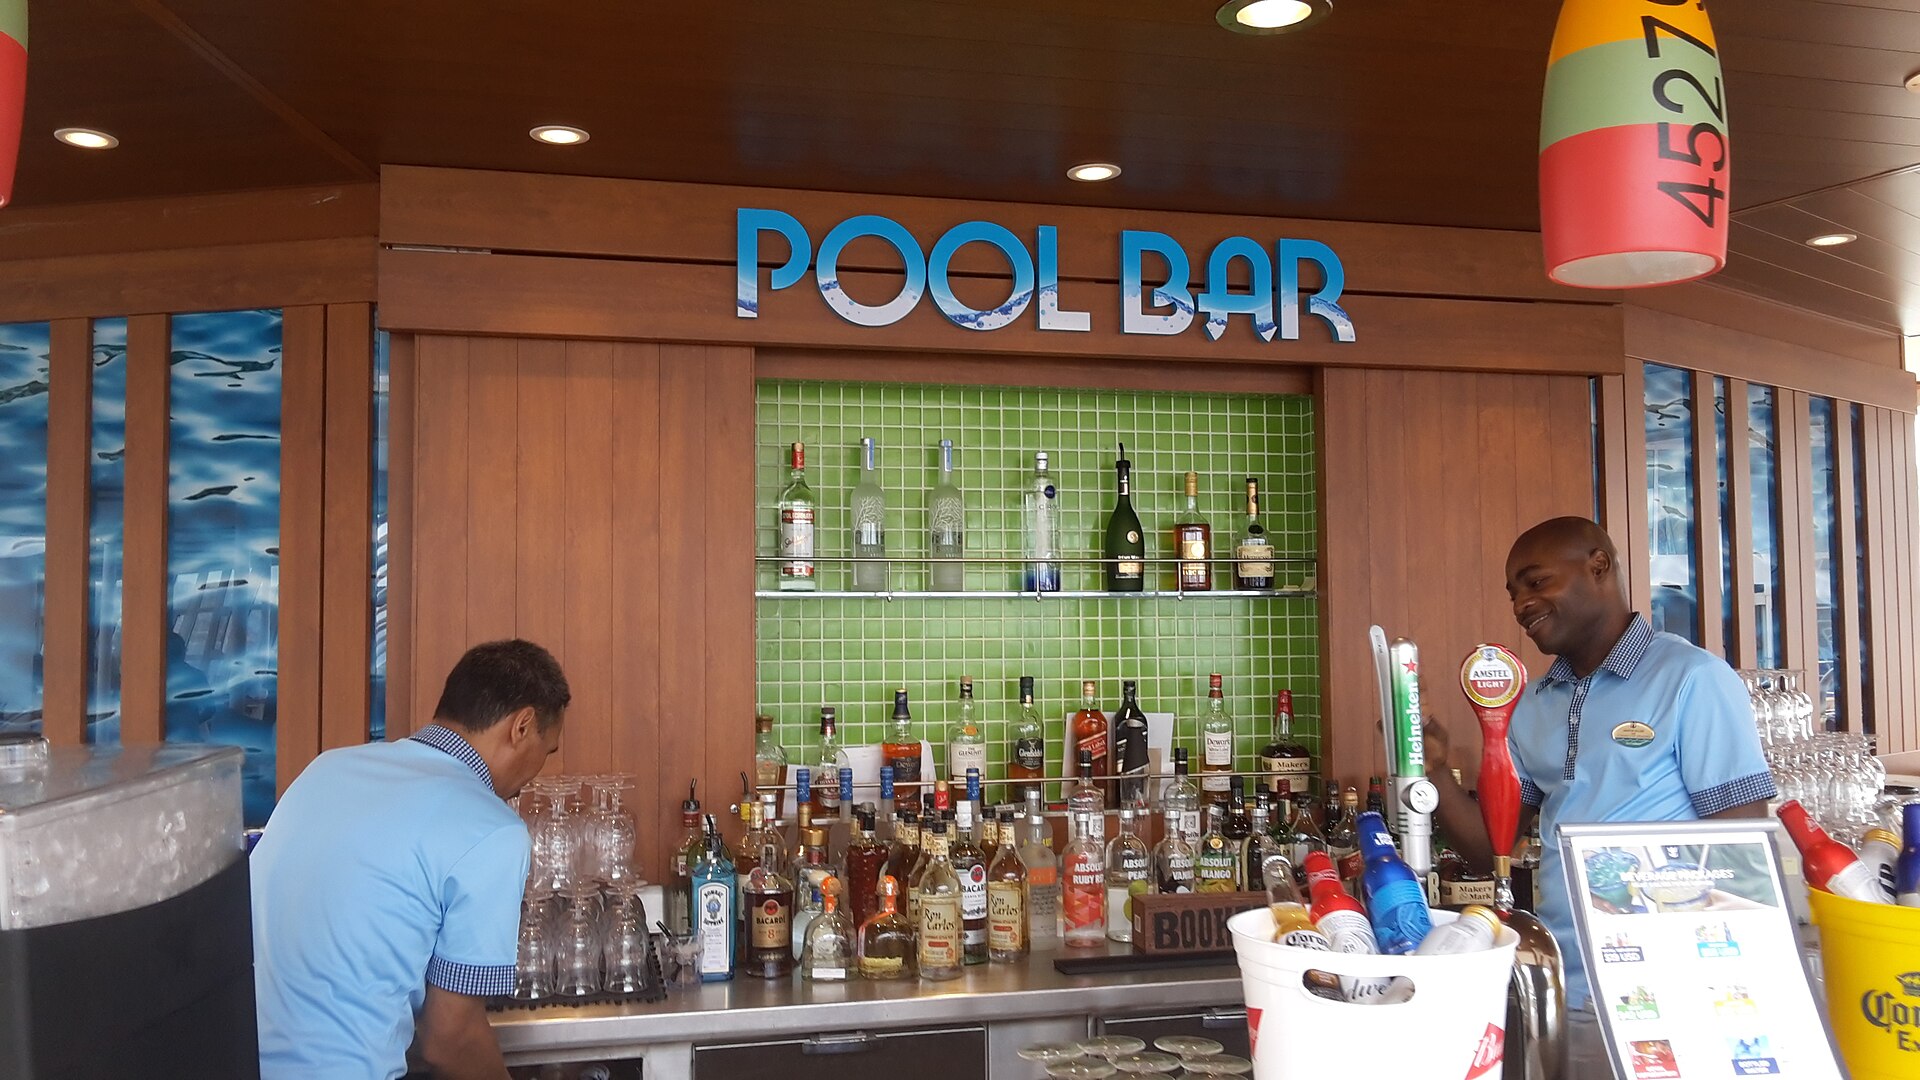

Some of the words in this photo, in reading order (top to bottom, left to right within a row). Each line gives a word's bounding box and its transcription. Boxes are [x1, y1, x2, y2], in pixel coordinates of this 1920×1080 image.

[1641, 0, 1725, 229] 4527
[737, 207, 1092, 333] POOL
[1119, 229, 1356, 344] BAR
[1472, 669, 1510, 678] AMSTEL
[1476, 680, 1505, 688] LIGHT
[1405, 680, 1425, 766] Heineken
[1200, 857, 1232, 867] ABSOLUT
[1072, 875, 1094, 885] RUBY
[1201, 869, 1231, 879] MANGO
[1458, 885, 1493, 893] Maker's
[990, 893, 1005, 906] Ron
[924, 908, 942, 921] Ron
[992, 904, 1019, 916] Carlos
[926, 918, 955, 931] Carlos
[1154, 907, 1236, 949] BOOK
